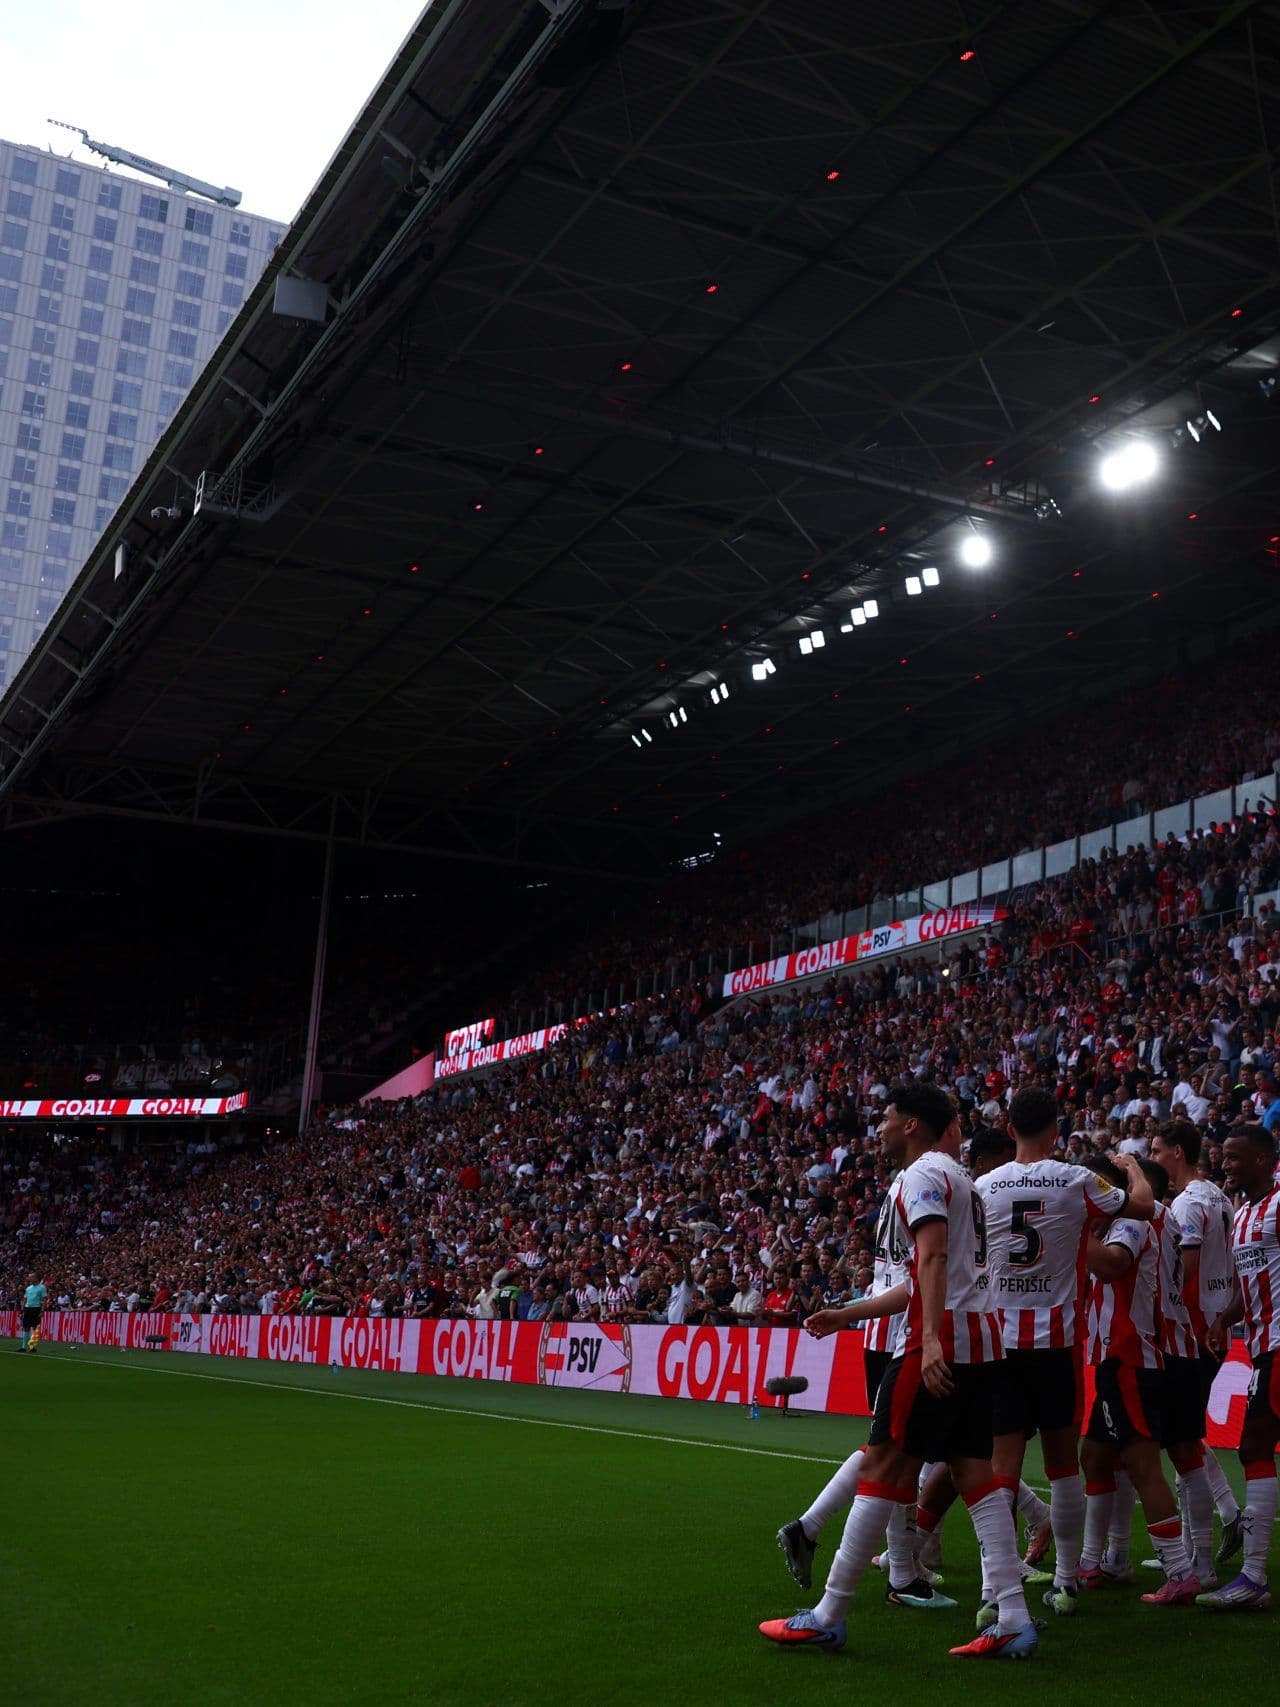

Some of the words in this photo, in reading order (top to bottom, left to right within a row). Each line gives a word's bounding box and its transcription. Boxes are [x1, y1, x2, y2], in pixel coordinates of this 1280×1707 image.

[731, 958, 779, 994] GOAL!
[795, 940, 848, 976] GOAL!
[872, 930, 891, 950] PSV
[918, 898, 983, 941] GOAL!
[472, 1043, 500, 1068] GOAL!
[509, 1031, 539, 1057] GOAL!
[51, 1100, 116, 1116] GOAL!
[142, 1098, 206, 1115] GOAL!
[990, 1176, 1068, 1194] goodhabitz
[1008, 1200, 1046, 1269] 5
[999, 1275, 1053, 1293] PERIŠIĆ
[95, 1312, 122, 1347] GOAL!
[133, 1312, 166, 1349] GOAL!
[180, 1322, 193, 1344] PSV
[209, 1314, 250, 1358] GOAL!
[267, 1315, 320, 1364] GOAL!
[341, 1316, 405, 1373] GOAL!
[432, 1319, 516, 1382] GOAL!
[566, 1337, 603, 1374] PSV
[657, 1324, 801, 1409] GOAL!
